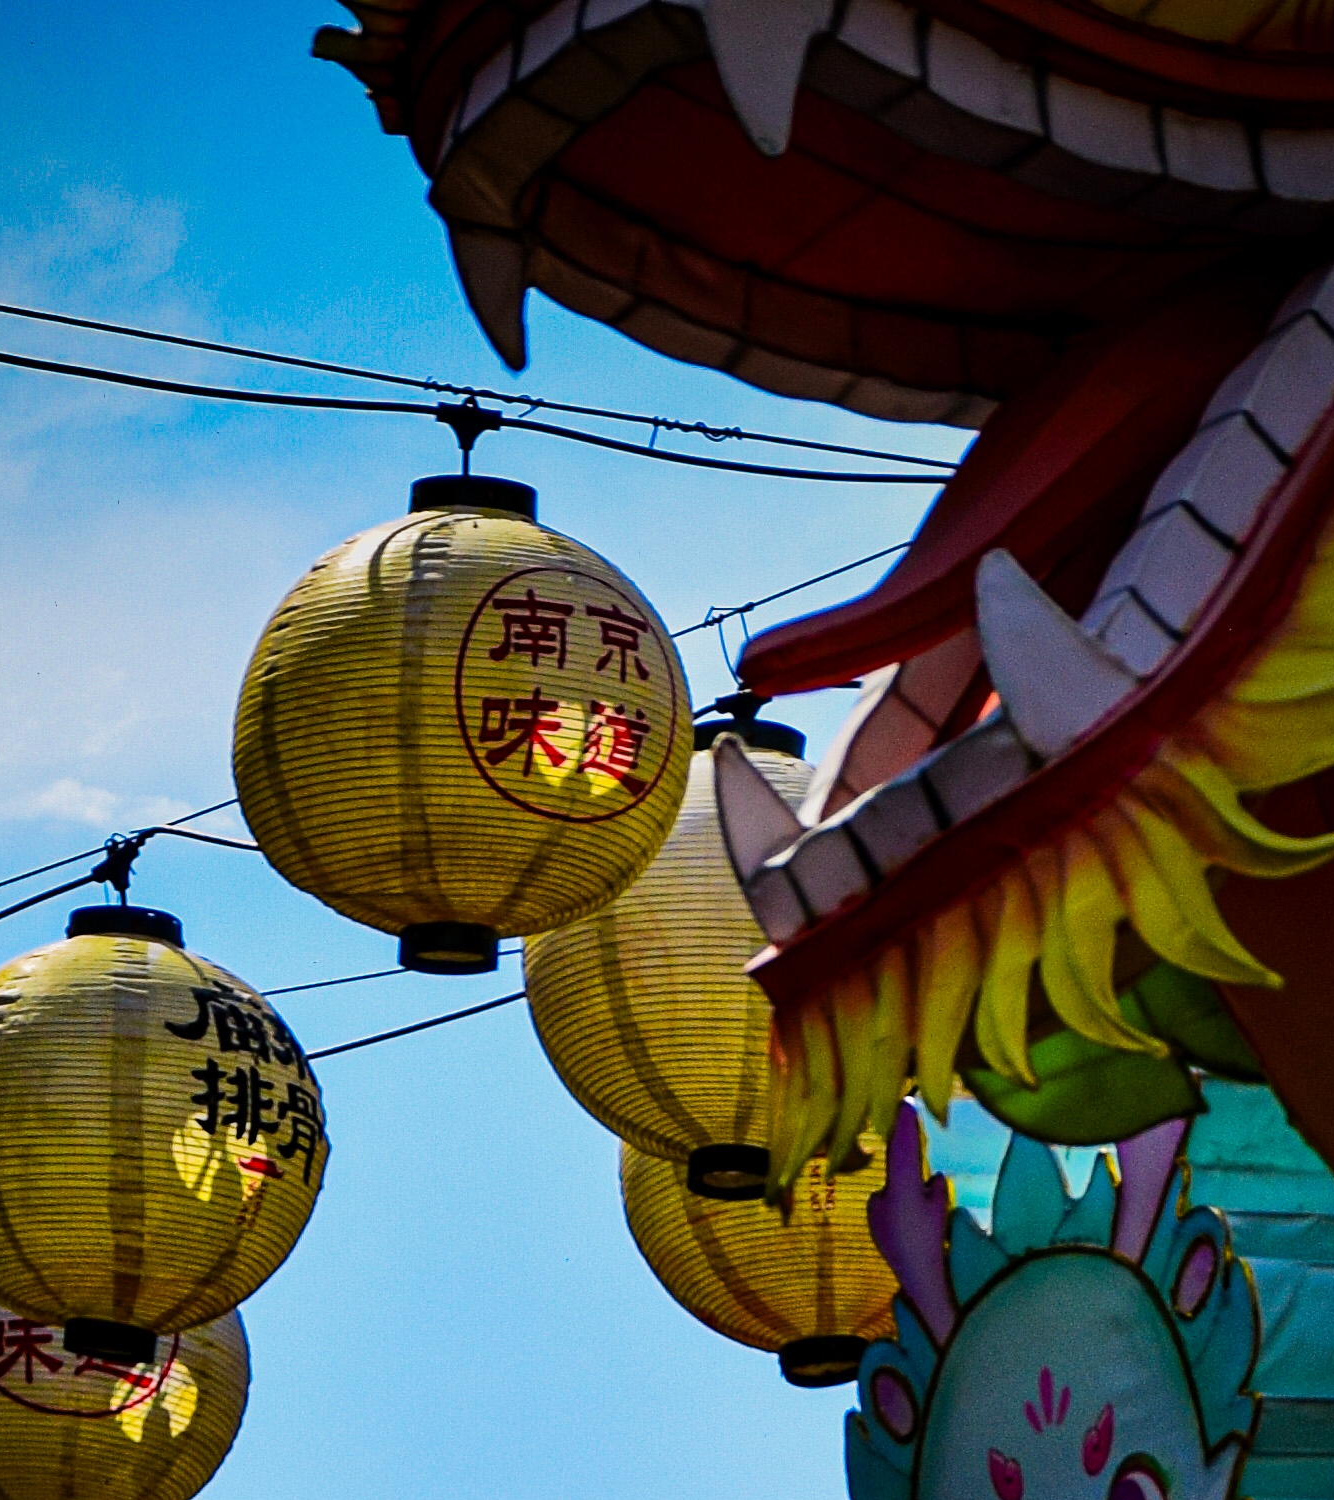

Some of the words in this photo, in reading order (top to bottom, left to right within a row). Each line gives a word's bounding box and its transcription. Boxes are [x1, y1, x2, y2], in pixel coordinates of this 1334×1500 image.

[492, 588, 649, 684] 南京
[480, 689, 650, 799] 味道
[191, 1058, 325, 1186] 排骨
